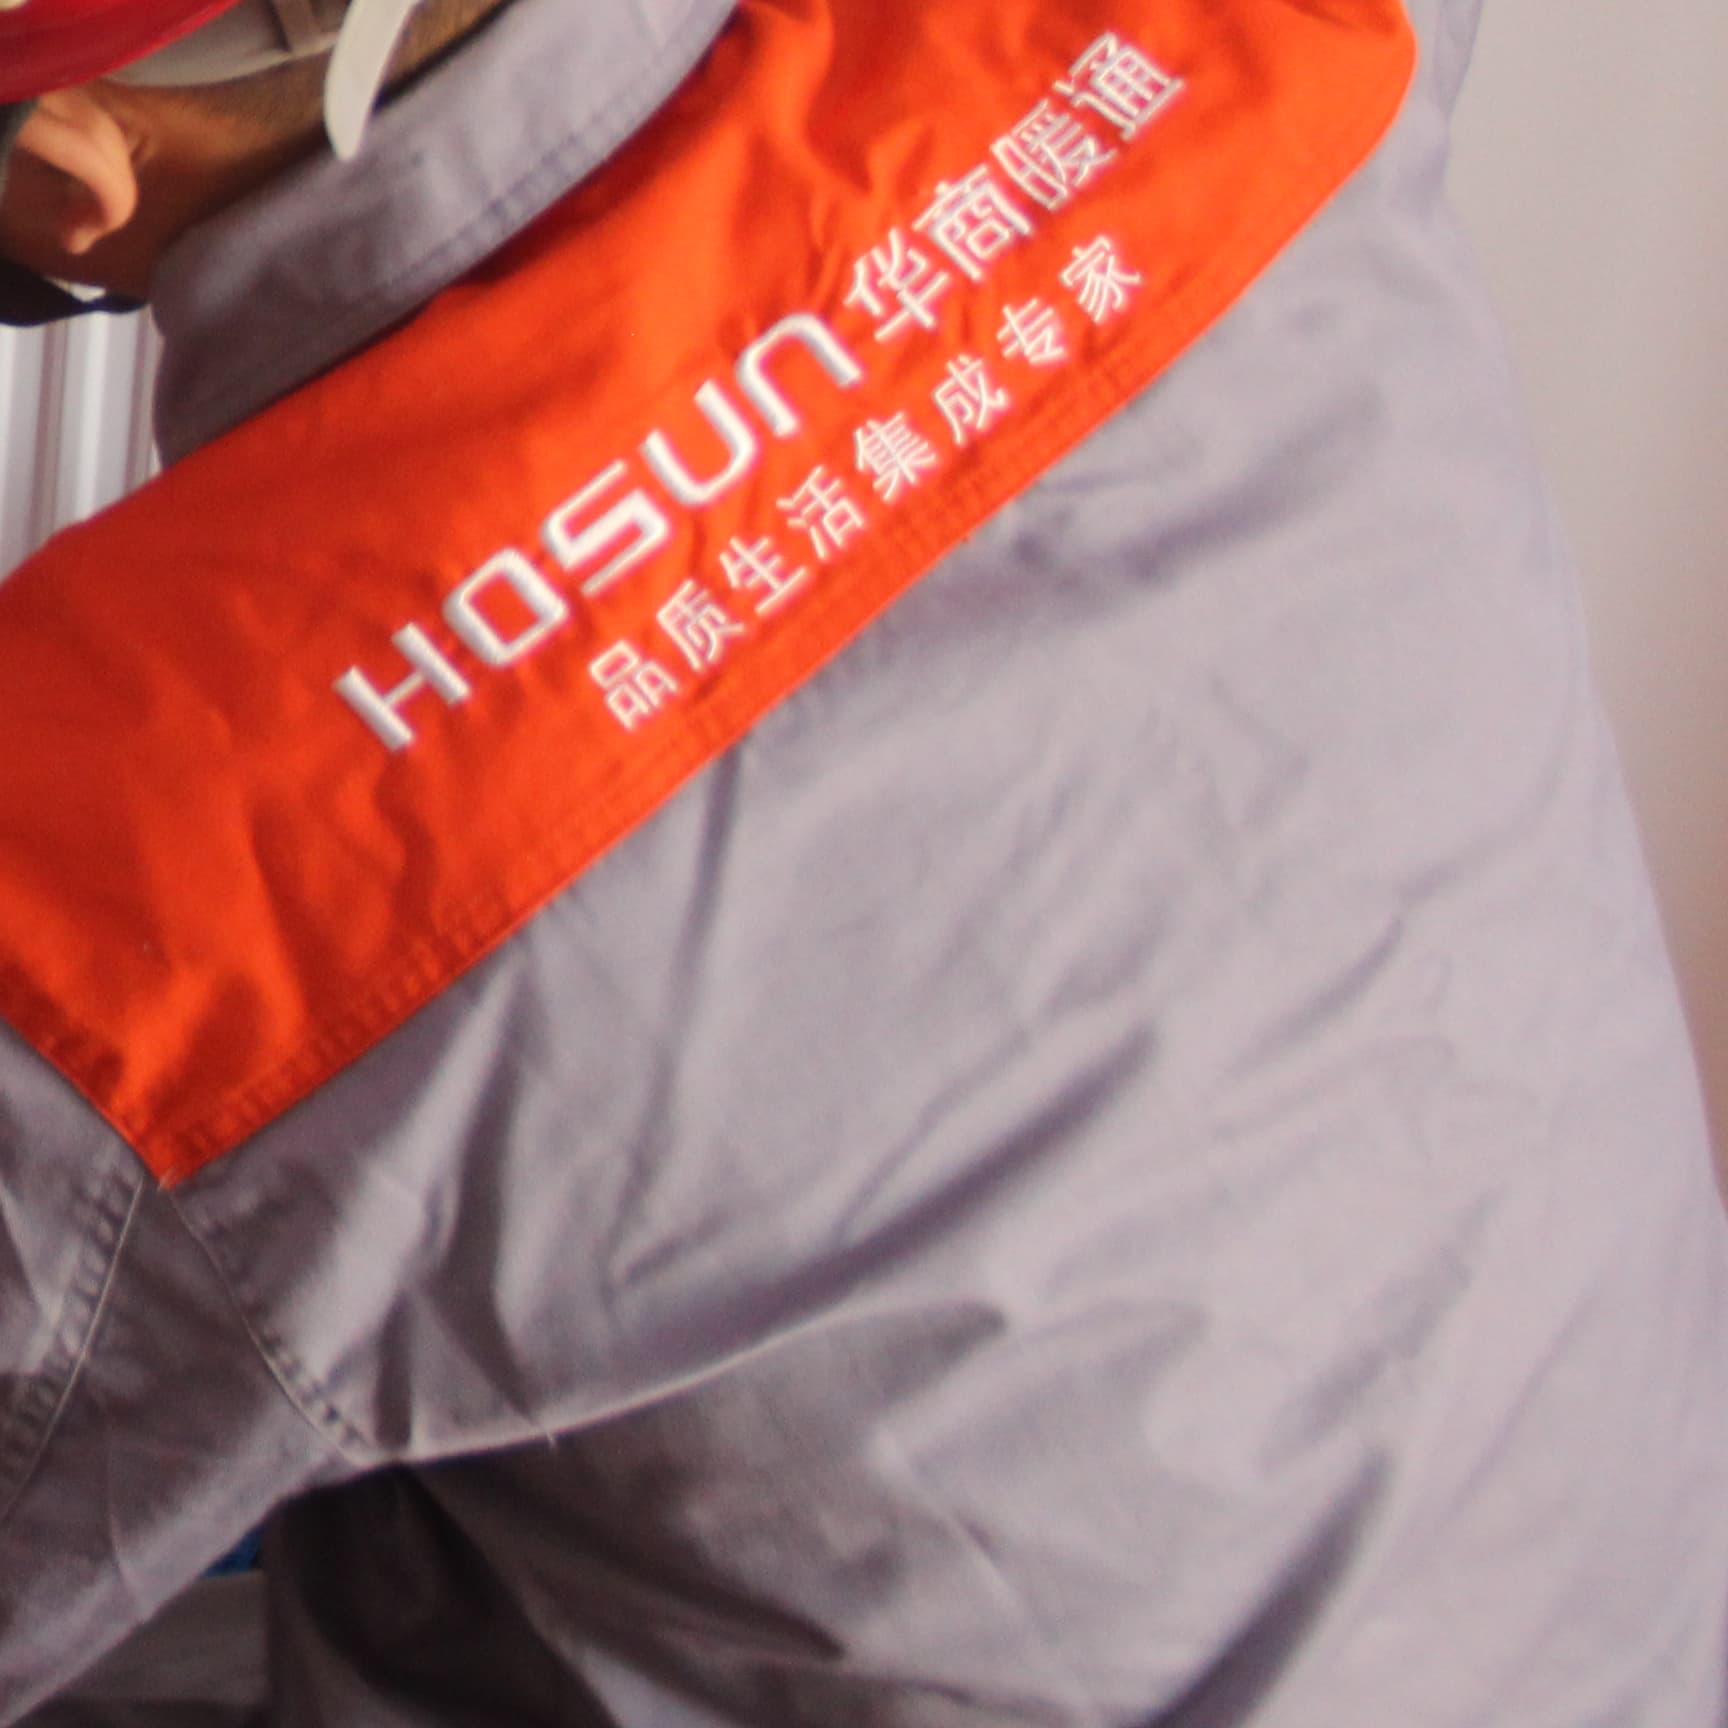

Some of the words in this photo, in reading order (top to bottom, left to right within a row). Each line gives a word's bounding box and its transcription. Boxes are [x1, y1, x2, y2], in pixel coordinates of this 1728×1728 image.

[334, 312, 862, 751] HOSUN
[842, 30, 1184, 344] 华商暖通
[587, 234, 1141, 731] 品质生活集成专家
